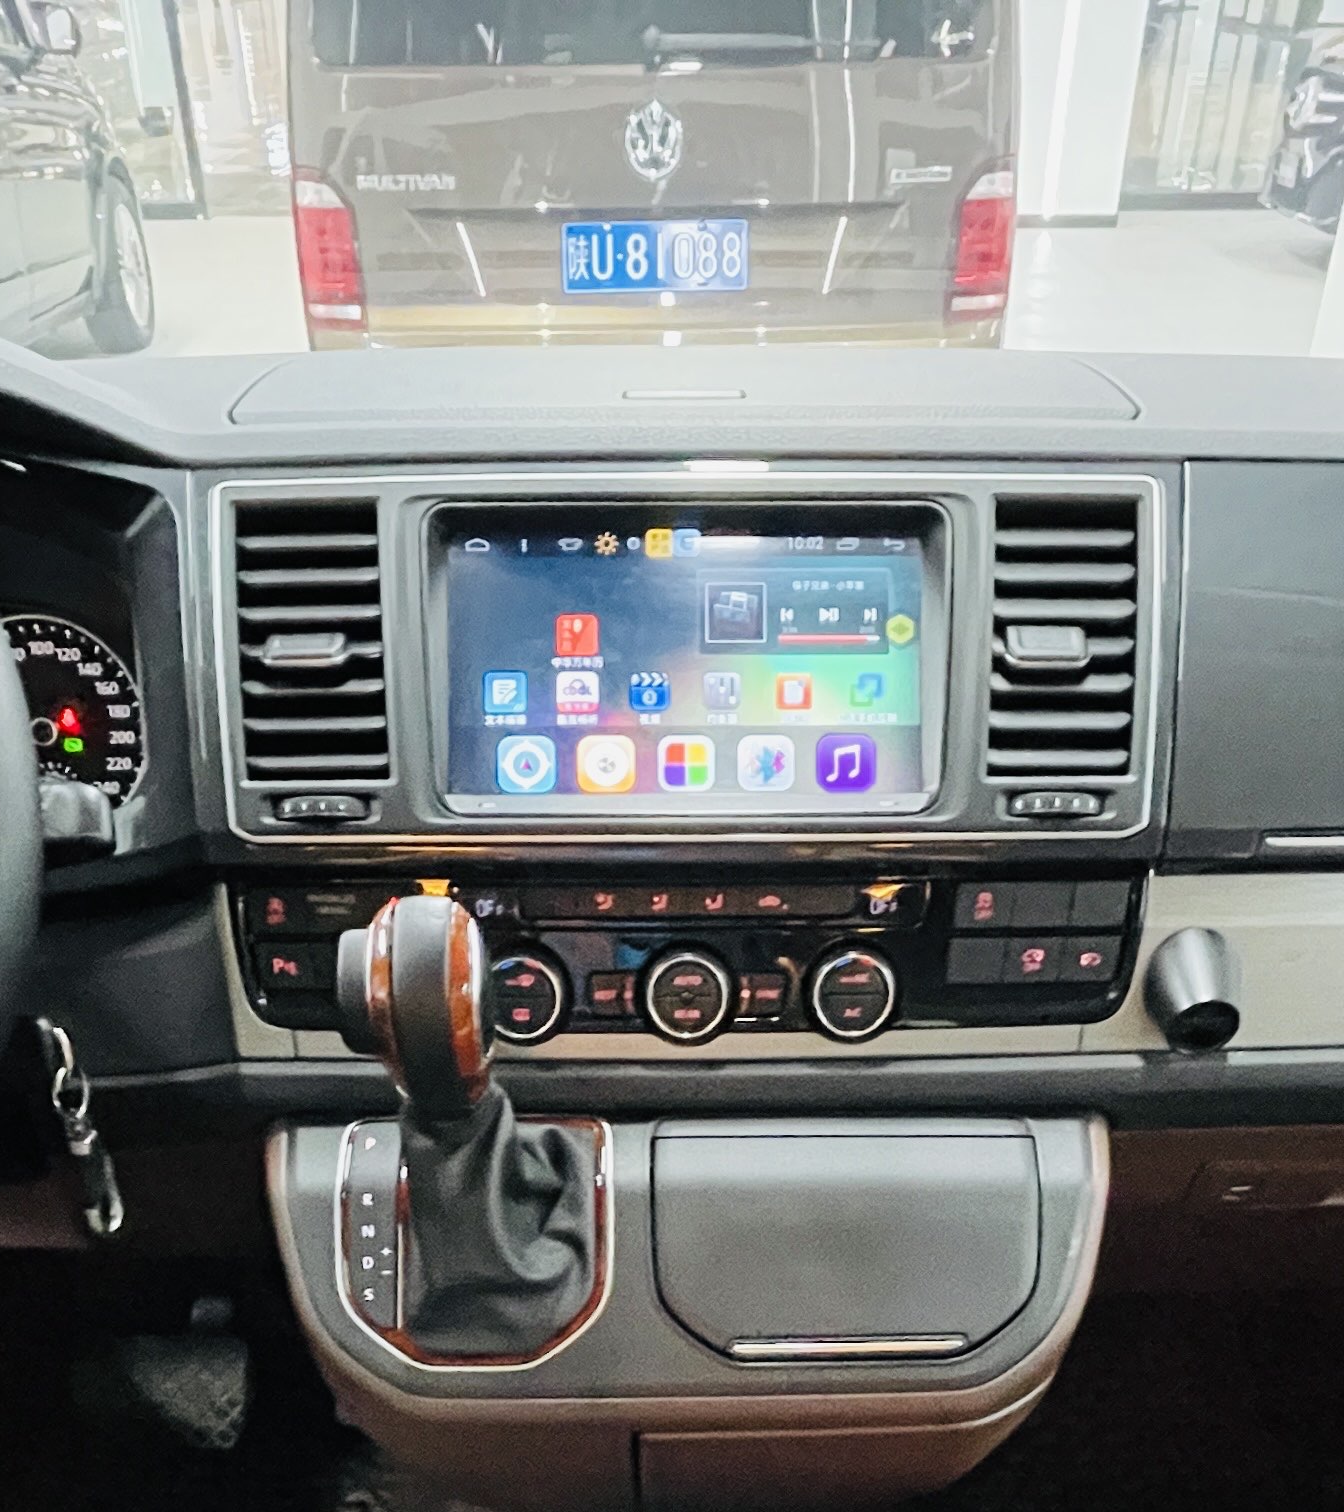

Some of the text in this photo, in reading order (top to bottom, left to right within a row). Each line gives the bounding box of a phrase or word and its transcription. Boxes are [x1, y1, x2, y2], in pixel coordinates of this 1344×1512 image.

[357, 173, 456, 191] MULTIVAN
[28, 640, 55, 655] 100
[56, 647, 82, 661] 120
[77, 662, 103, 676] 140
[94, 681, 120, 695] 160
[107, 704, 131, 718] 180
[109, 730, 135, 744] 200
[106, 756, 132, 770] 220
[364, 1136, 377, 1150] P
[362, 1192, 375, 1206] R
[361, 1224, 375, 1238] N
[362, 1256, 375, 1270] D
[363, 1287, 375, 1301] S
